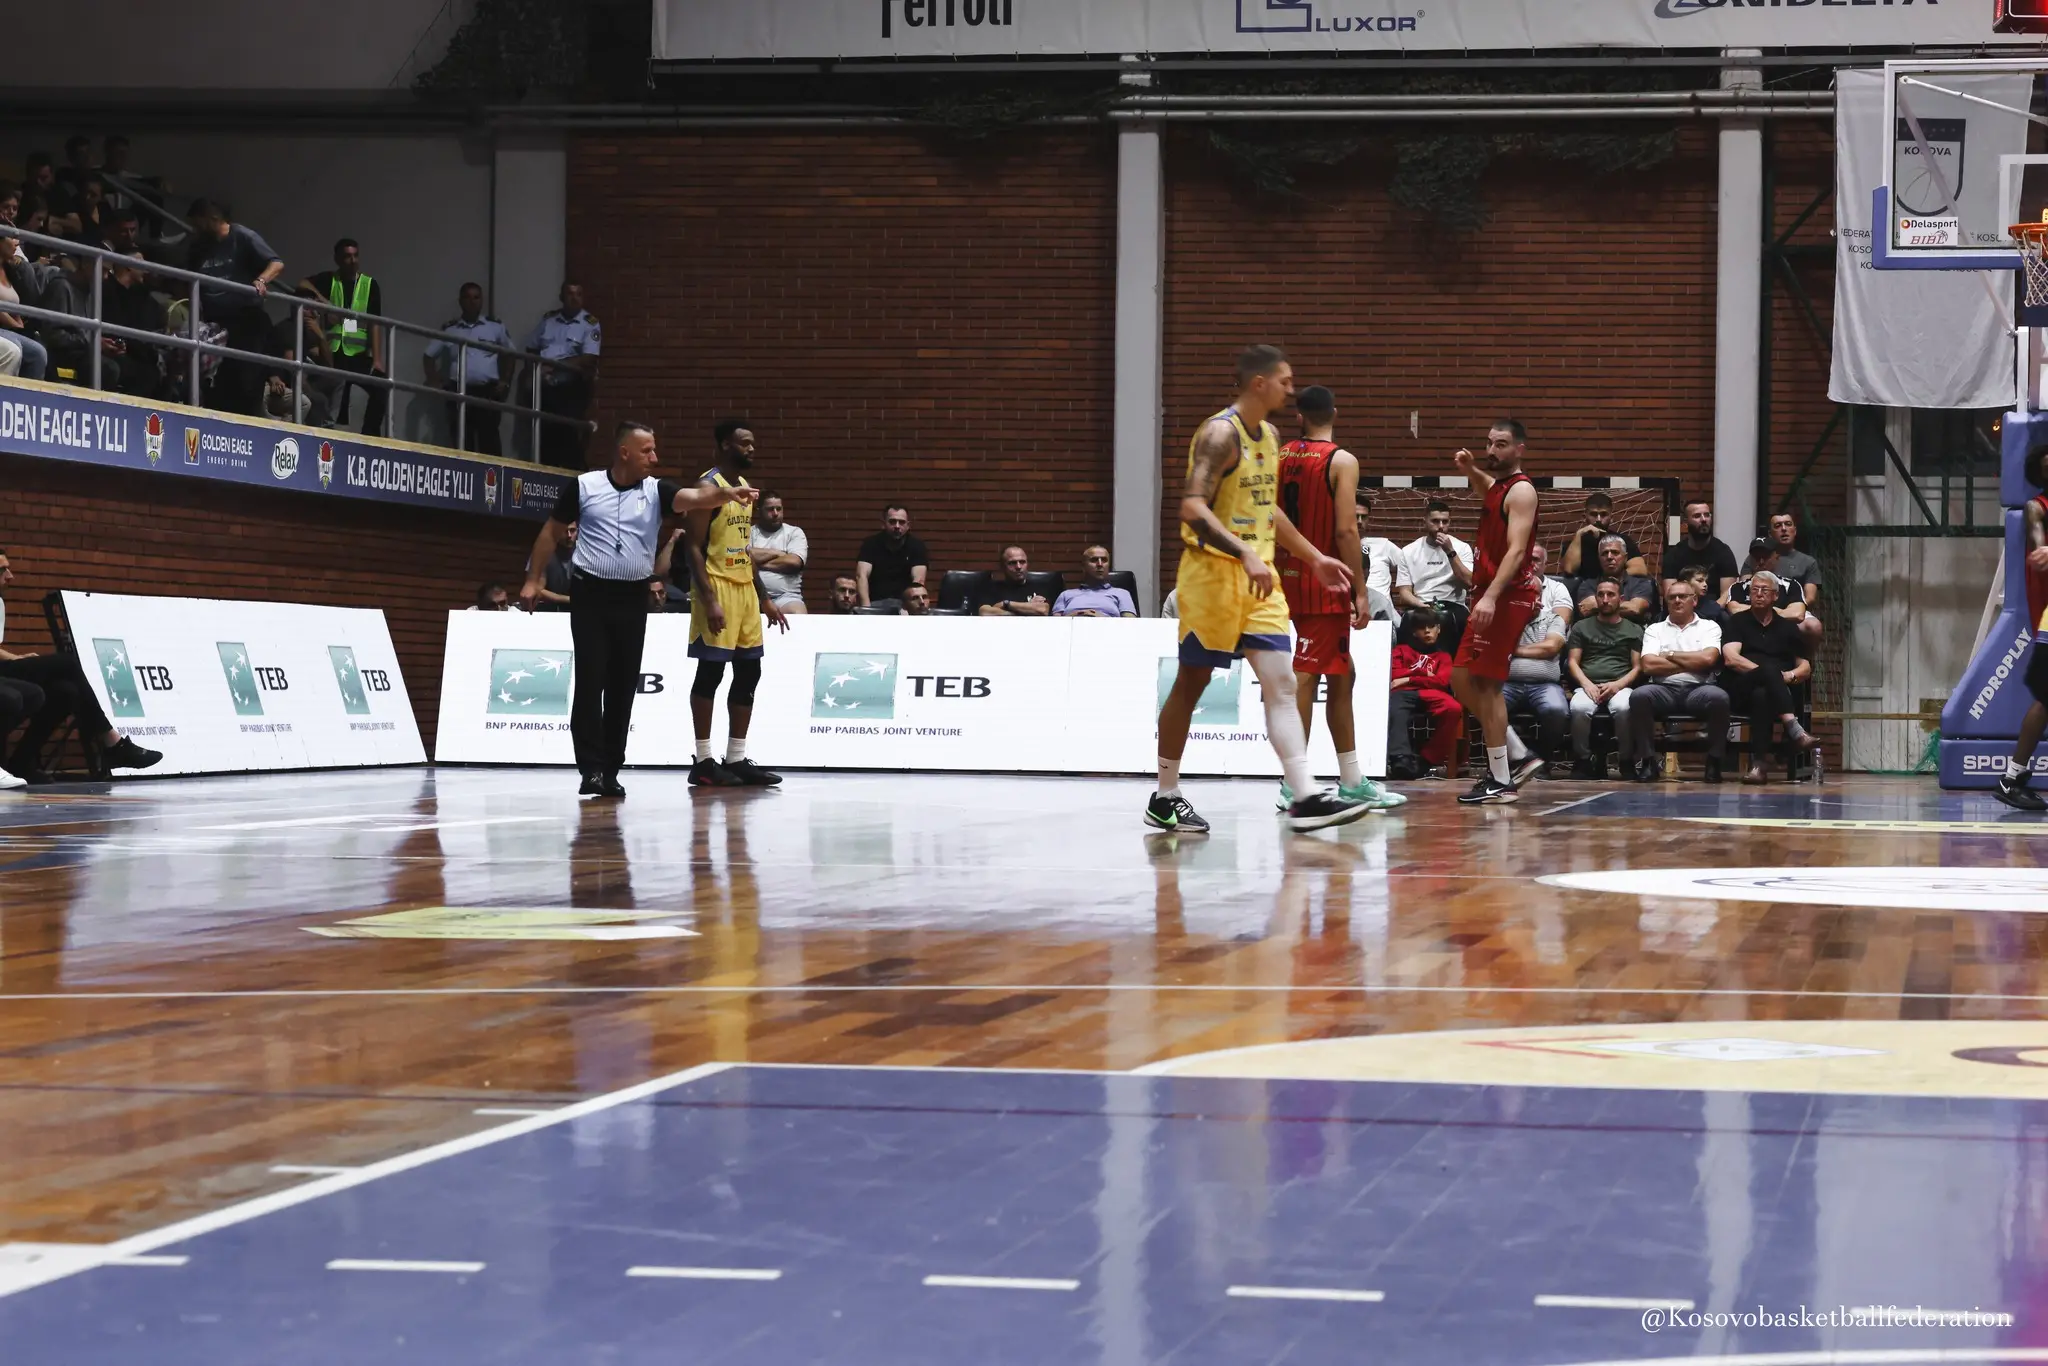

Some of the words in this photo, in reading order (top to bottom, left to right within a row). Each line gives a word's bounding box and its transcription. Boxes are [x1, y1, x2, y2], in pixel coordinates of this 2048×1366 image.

[1910, 219, 1958, 230] Delasport
[1909, 235, 1945, 245] BIBL
[0, 401, 36, 441] DEN
[40, 407, 91, 449] EAGLE
[94, 414, 128, 453] YLLI
[201, 433, 231, 453] GOLDEN
[230, 438, 253, 456] EAGLE
[207, 455, 228, 466] ENERGY
[274, 444, 298, 472] Relax
[346, 454, 369, 488] K.B.
[370, 458, 416, 494] GOLDEN
[416, 464, 451, 498] EAGLE
[452, 469, 475, 501] YLLI
[523, 482, 544, 497] GOLDEN
[135, 665, 174, 691] TEB
[254, 667, 289, 691] TEB
[361, 669, 391, 692] TEB
[1968, 627, 2033, 721] HYDROPLAY
[906, 675, 992, 699] TEB
[485, 721, 507, 730] BNP
[510, 721, 554, 732] PARIBAS
[809, 725, 832, 735] BNP
[835, 726, 880, 736] PARIBAS
[883, 726, 913, 736] JOINT
[915, 727, 964, 737] VENTURE
[1187, 731, 1226, 741] ARIBAS
[1228, 732, 1260, 742] JOINT
